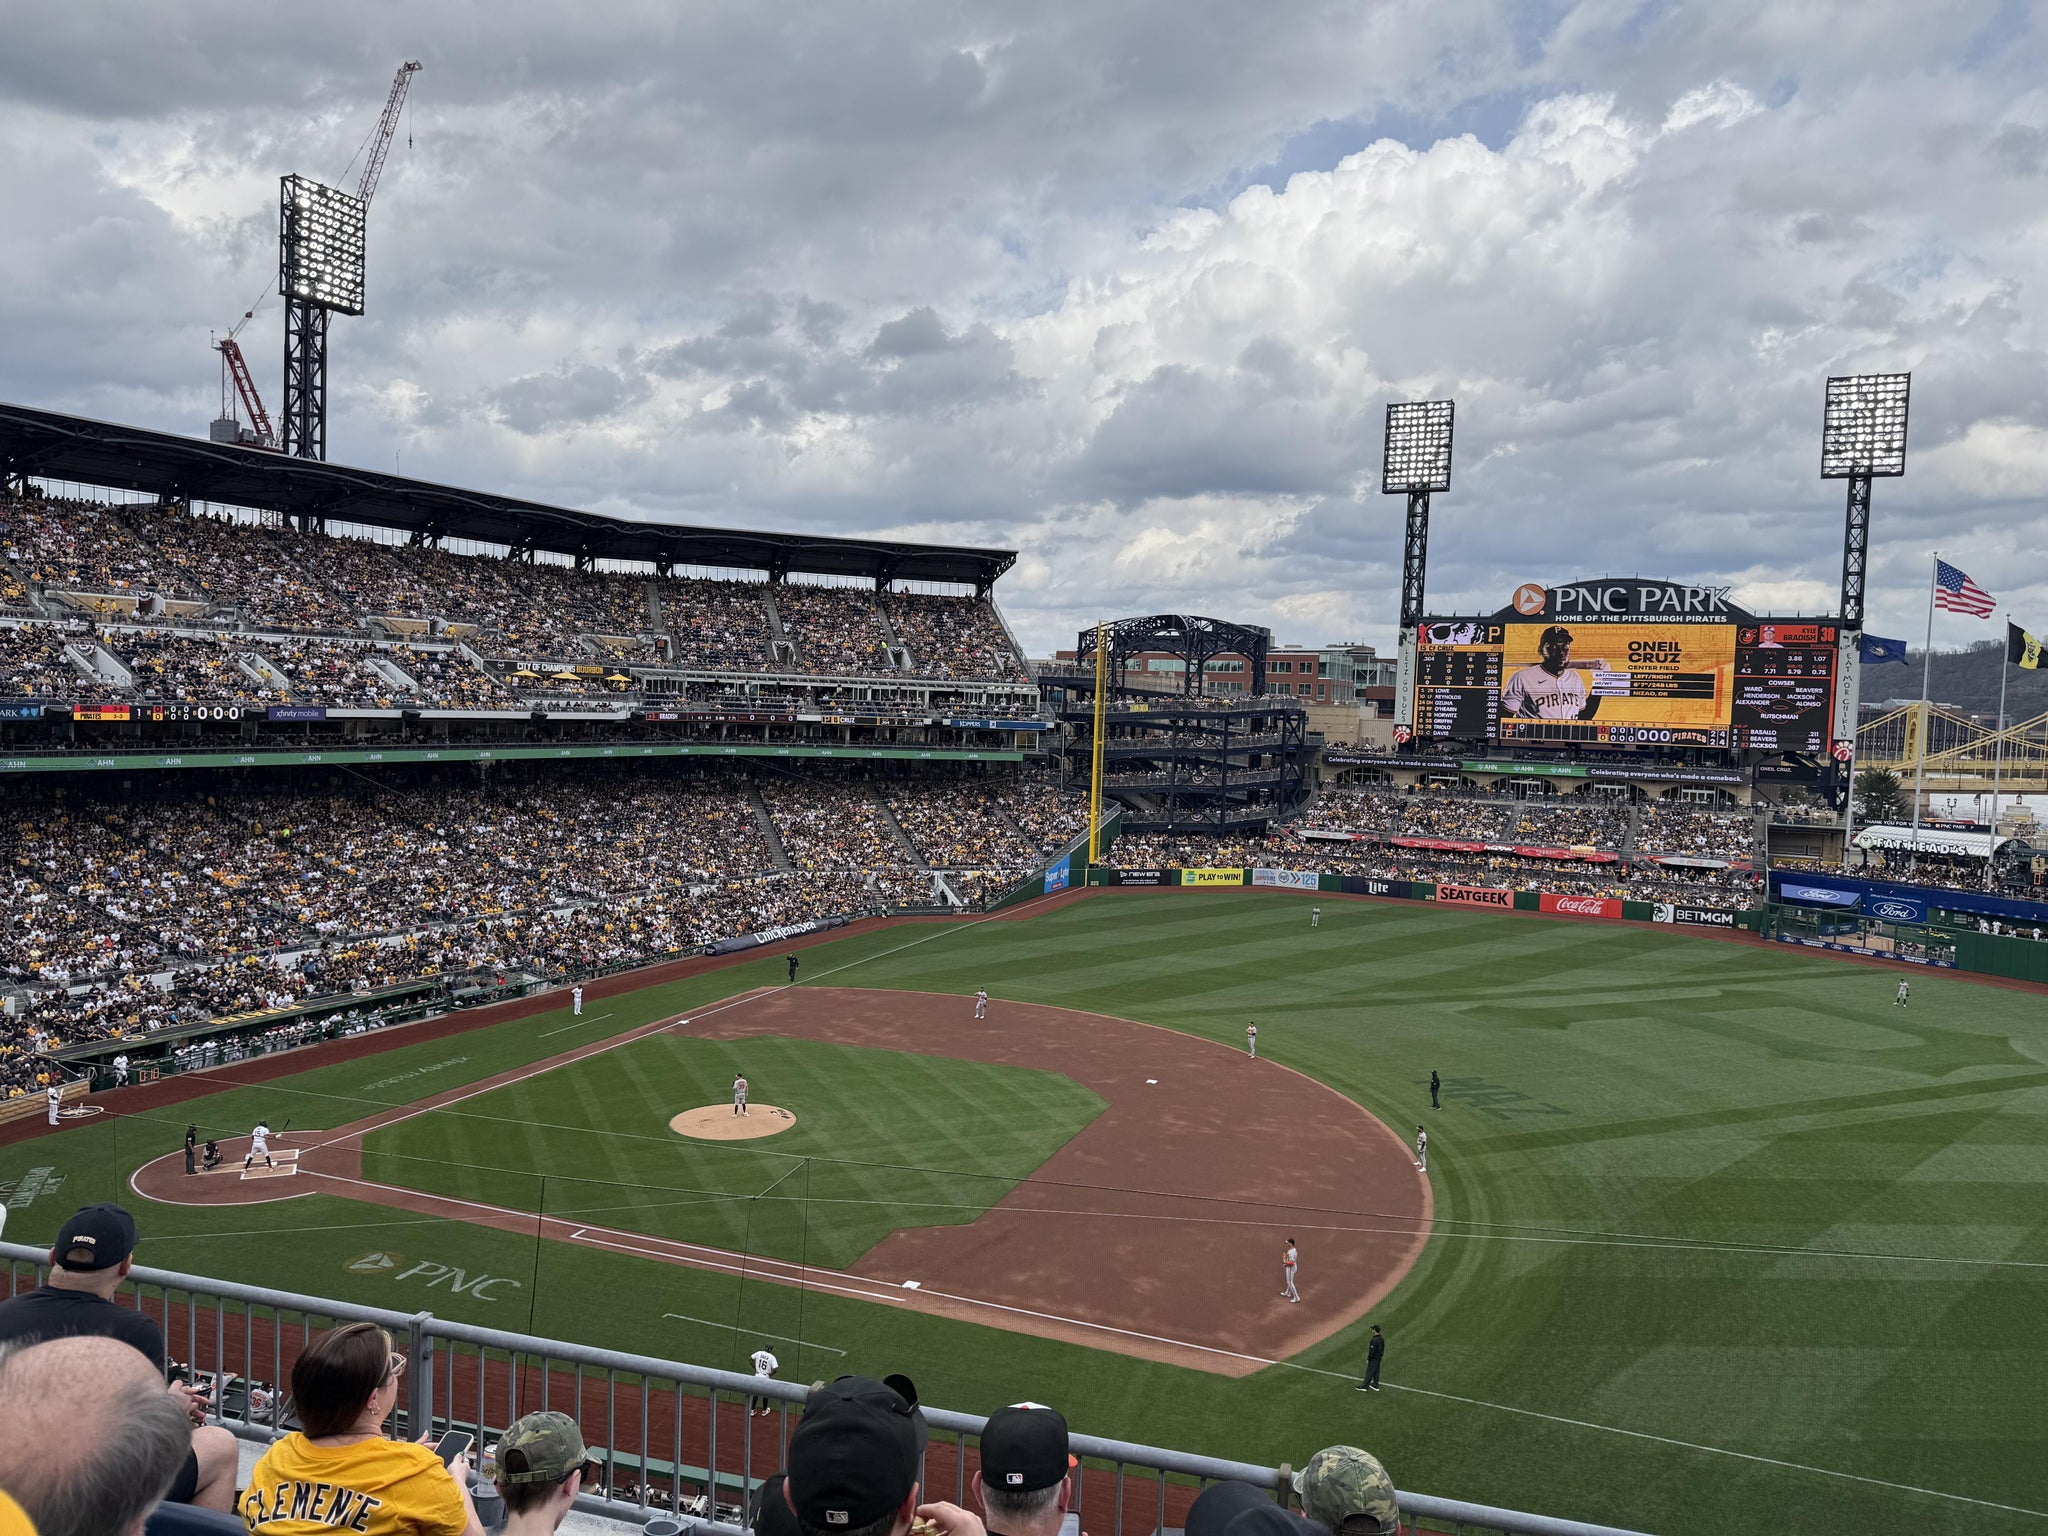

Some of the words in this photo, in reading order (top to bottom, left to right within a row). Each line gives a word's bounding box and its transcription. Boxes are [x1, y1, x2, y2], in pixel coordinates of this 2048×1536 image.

[1553, 587, 1627, 612] PNC
[1637, 587, 1732, 612] PARK
[1821, 627, 1835, 642] 38
[1628, 641, 1681, 652] ONEIL
[1628, 653, 1680, 663] CRUZ
[517, 662, 528, 670] CITY
[541, 663, 575, 673] CHAMPIONS
[576, 666, 603, 674] BOURBON
[1843, 675, 1852, 695] MOR
[276, 710, 297, 718] xfinity
[1841, 700, 1849, 738] CHIKIN
[1672, 732, 1706, 743] PIRATES
[1591, 769, 1629, 777] Celebrating
[1877, 839, 1902, 850] FAT
[1908, 841, 1971, 856] HEAD'S
[1301, 874, 1316, 885] 125
[1368, 882, 1389, 894] Lite
[1440, 887, 1509, 906] SEATGEEK
[1804, 890, 1833, 899] Ford
[1676, 910, 1733, 923] BETMGM
[1880, 903, 1910, 918] Ford
[754, 927, 794, 944] Chicken
[800, 921, 816, 933] Sea
[72, 1236, 96, 1244] PIRATES
[395, 1260, 521, 1301] PNC
[759, 1359, 767, 1370] 16
